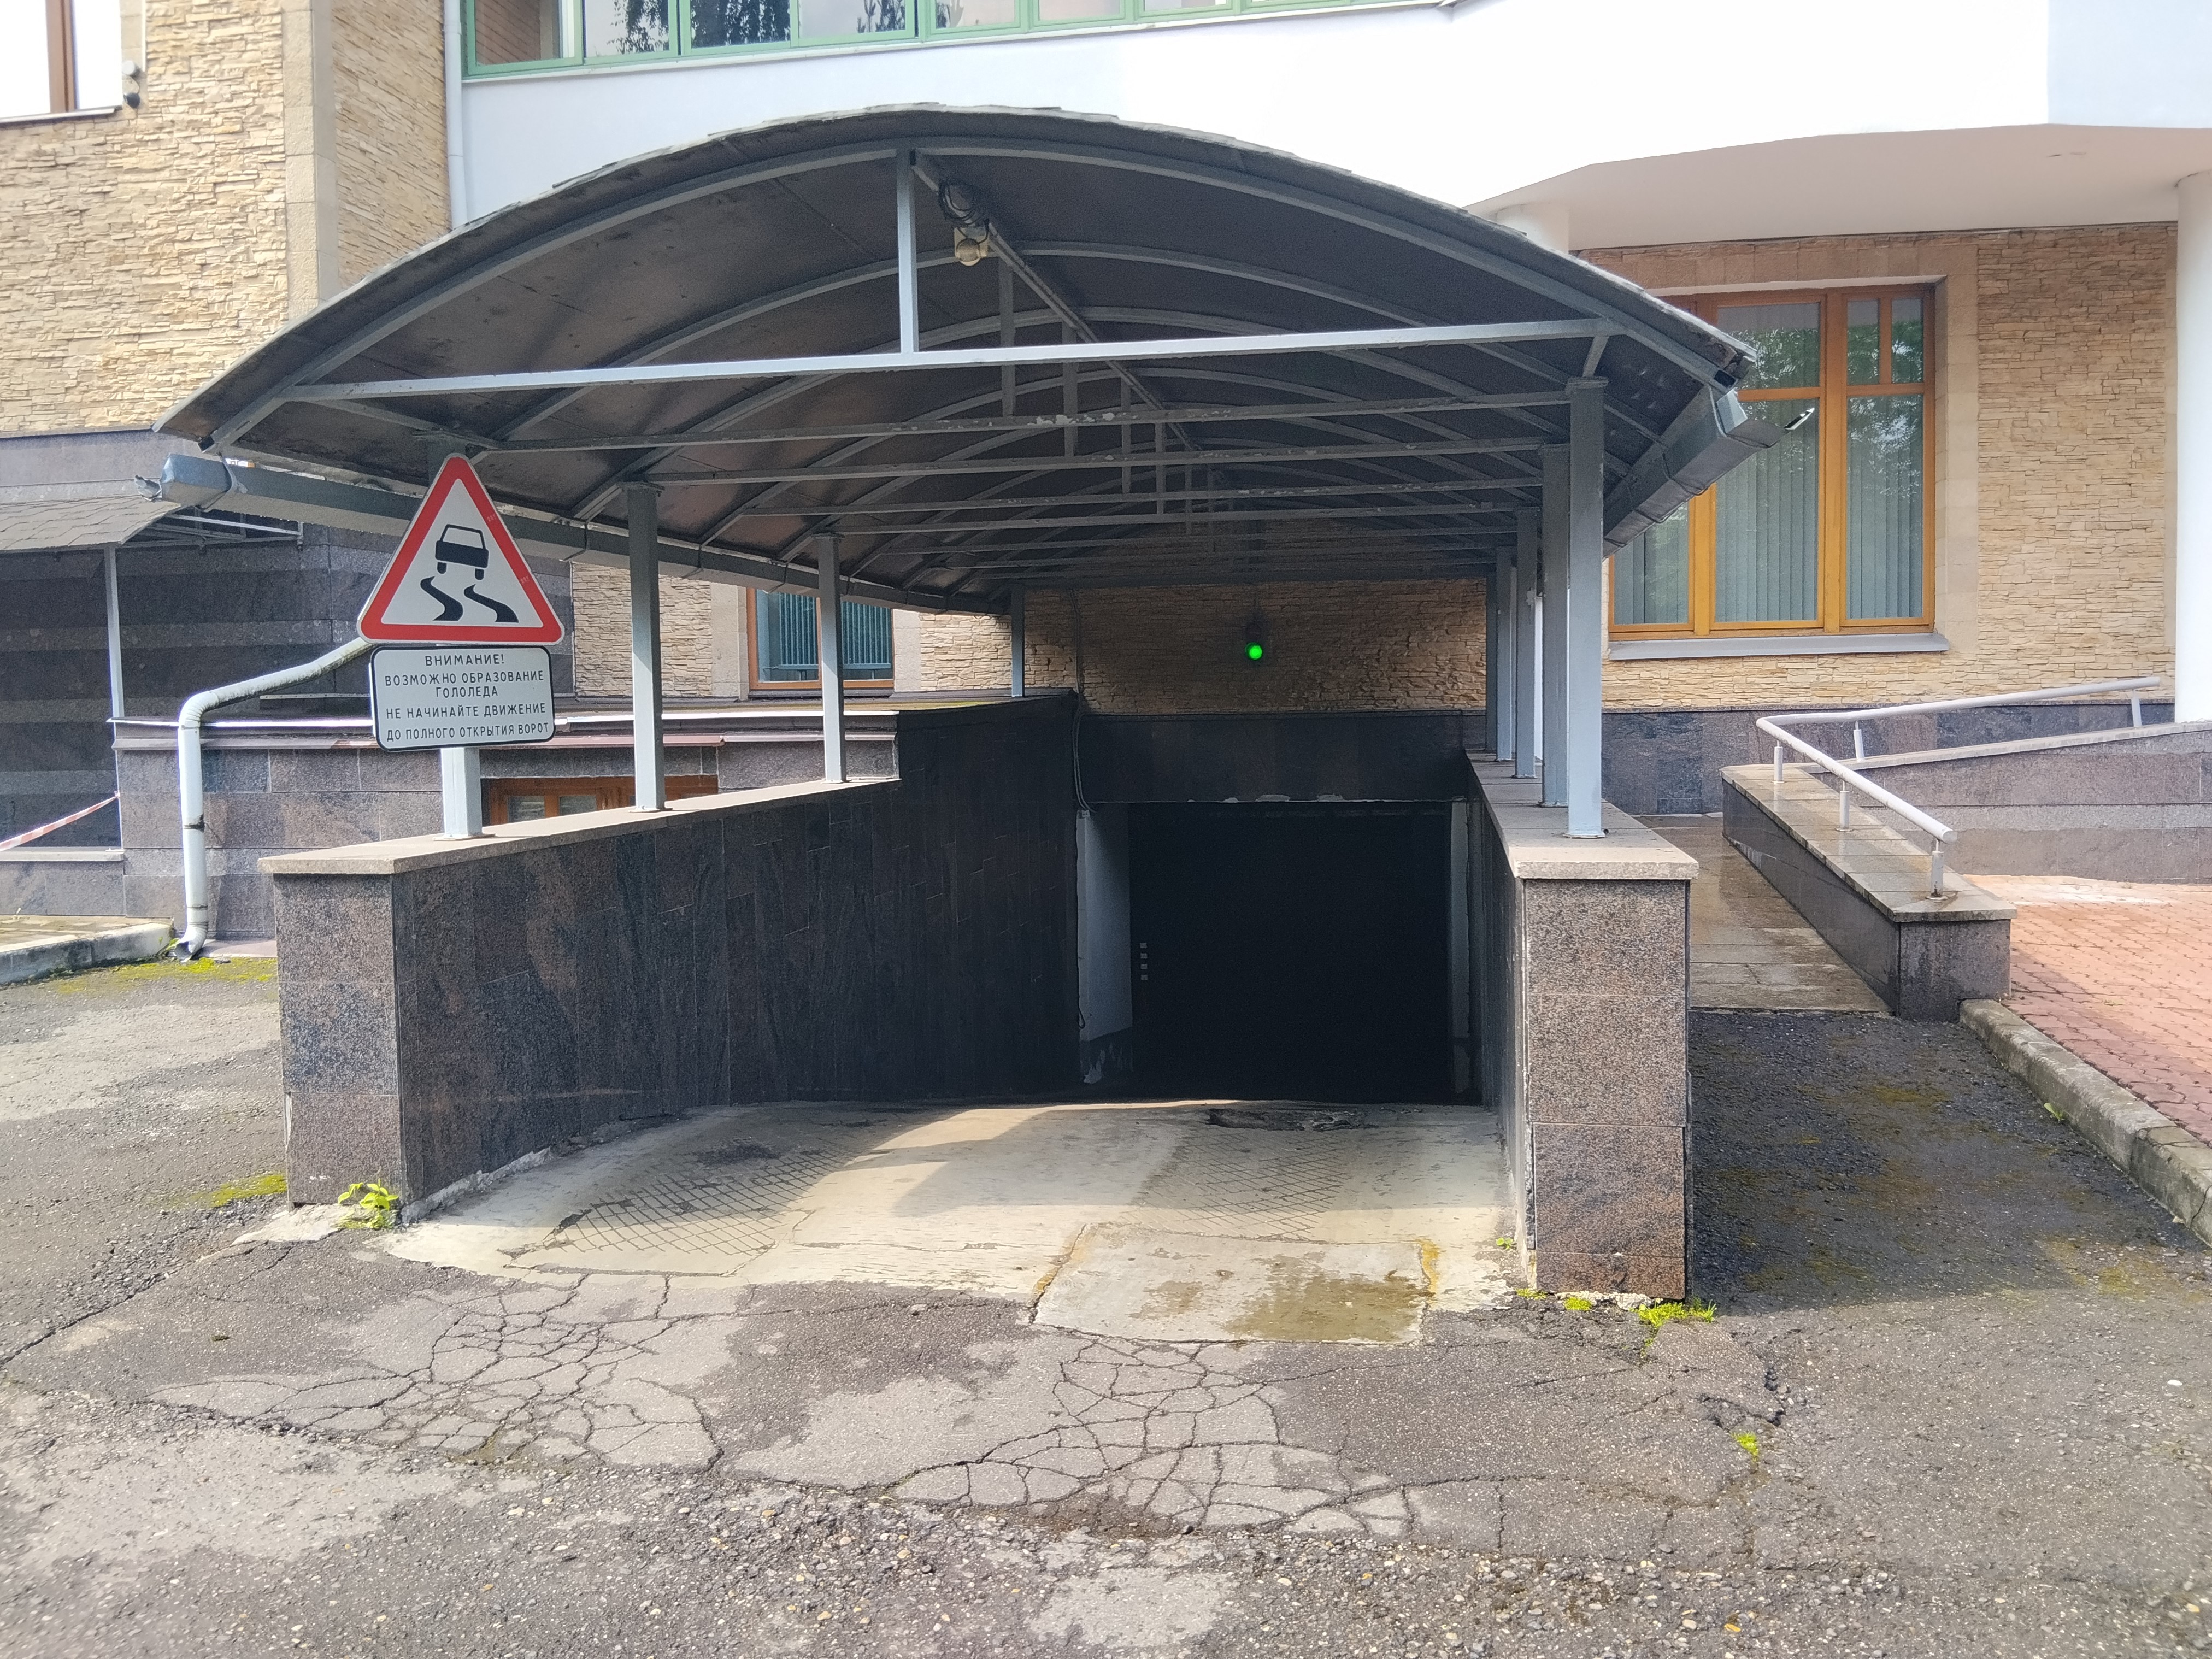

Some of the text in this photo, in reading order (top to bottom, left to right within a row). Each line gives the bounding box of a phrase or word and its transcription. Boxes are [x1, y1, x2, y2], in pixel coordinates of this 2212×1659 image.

[425, 654, 505, 666] ВНИМАНИЕ!
[385, 670, 544, 686] ВОЗМОЖНО ОБРАЗОВАНИЕ
[436, 685, 498, 698] ГОЛОЛЕДА
[386, 702, 546, 719] НЕ НАЧИНАЙТЕ ДВИЖЕНИЕ
[386, 722, 549, 742] ДО ПОЛНОГО ОТКРЫТИЯ ВОРОТ
